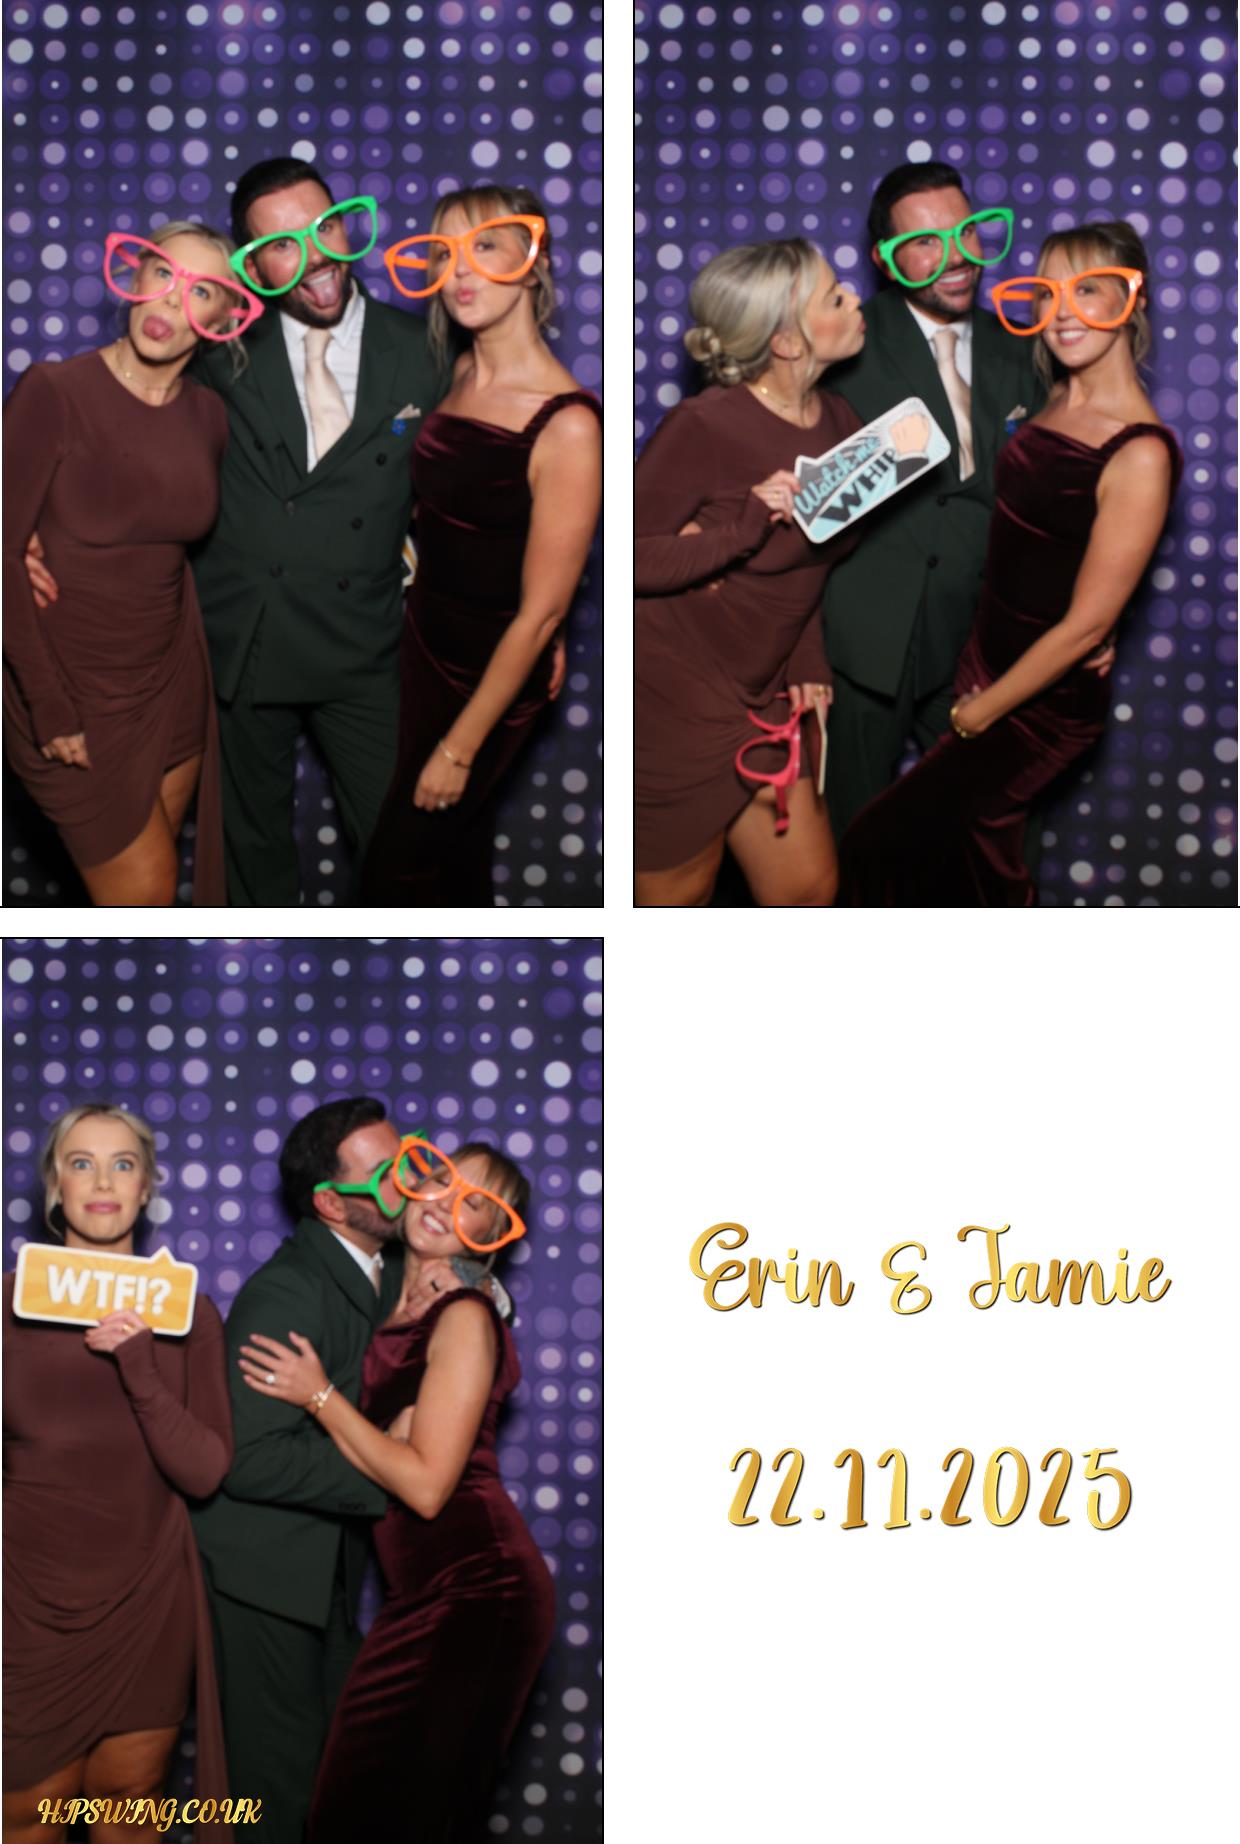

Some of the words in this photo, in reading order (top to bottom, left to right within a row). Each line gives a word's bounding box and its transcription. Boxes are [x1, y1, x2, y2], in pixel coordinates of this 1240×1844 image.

[794, 451, 851, 515] Watch
[818, 448, 896, 522] WHIP
[47, 1264, 172, 1315] WTF!?
